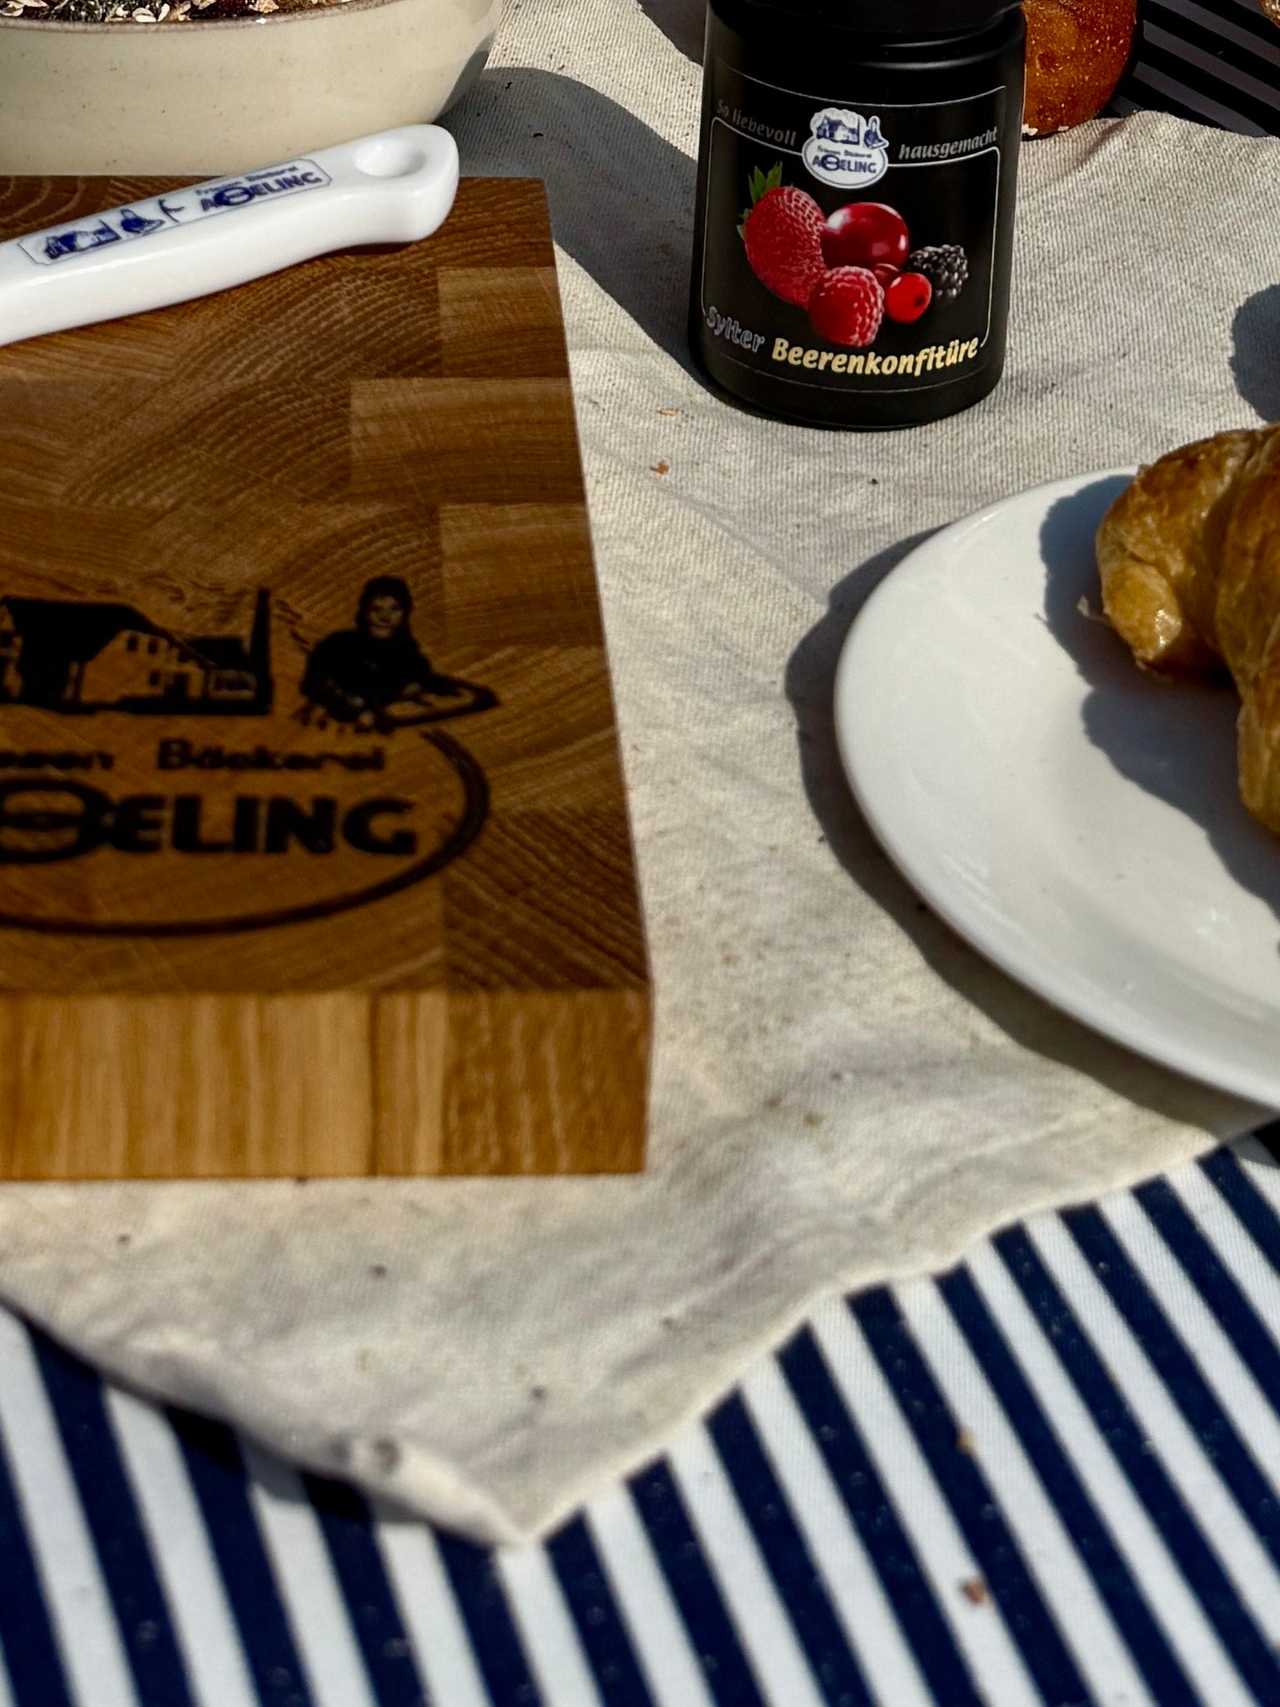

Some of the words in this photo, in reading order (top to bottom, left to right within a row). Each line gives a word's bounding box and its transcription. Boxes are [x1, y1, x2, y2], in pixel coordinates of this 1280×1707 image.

[715, 99, 730, 119] So
[732, 109, 797, 147] liebevoll
[898, 125, 998, 161] hausgemacht
[705, 306, 766, 354] Sylter
[771, 336, 979, 377] Beerenkonfitüre
